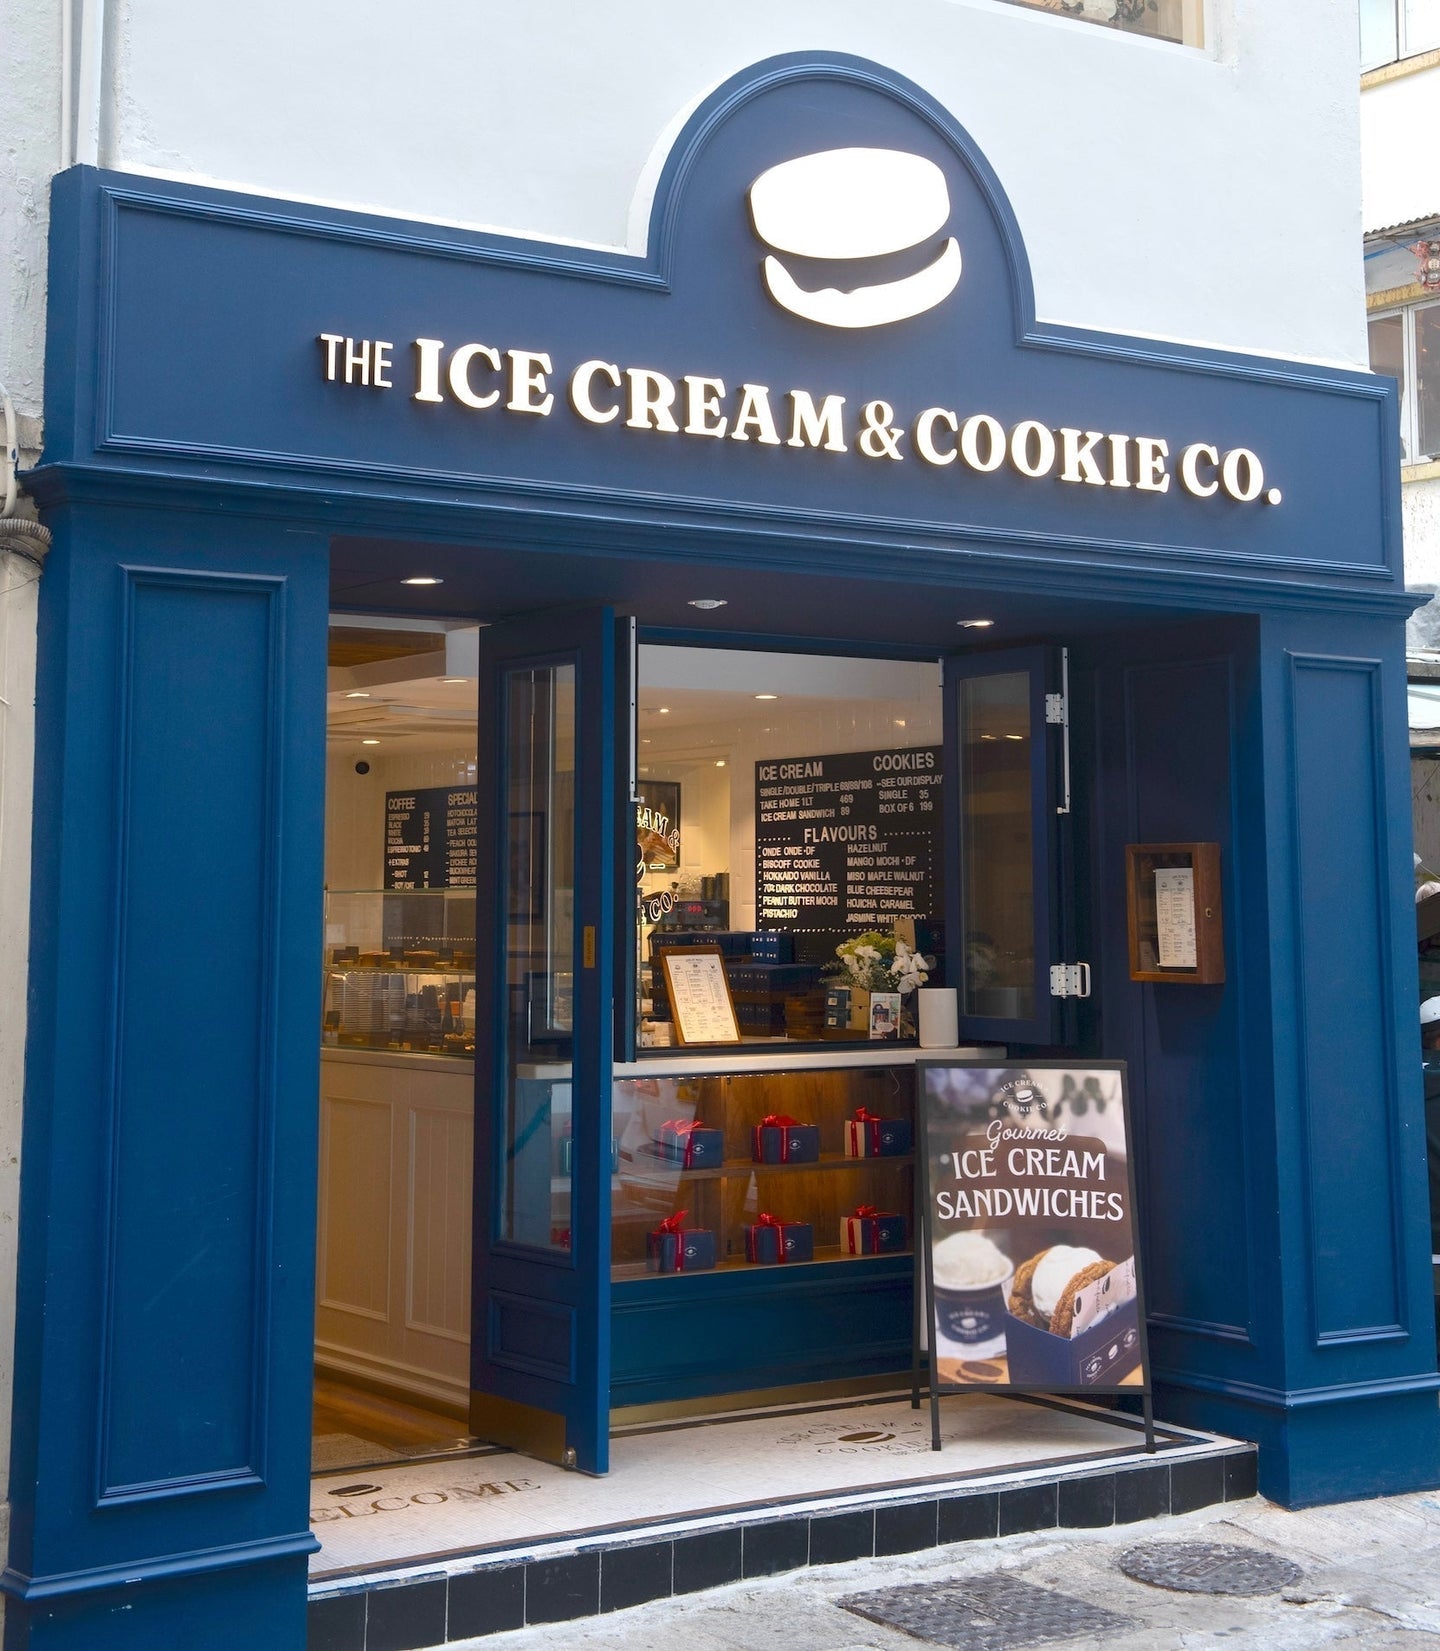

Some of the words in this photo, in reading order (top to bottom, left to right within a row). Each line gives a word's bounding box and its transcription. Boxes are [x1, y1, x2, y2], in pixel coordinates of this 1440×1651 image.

[320, 333, 394, 388] THE
[414, 338, 554, 416] ICE
[571, 360, 848, 453] CREAM
[858, 400, 904, 461] &
[915, 407, 1170, 493] COOKIE
[1181, 443, 1282, 506] CO.
[873, 752, 935, 771] COOKIES
[759, 766, 777, 781] ICE
[780, 761, 823, 779] CREAM
[913, 774, 943, 785] DISPLAY
[879, 790, 908, 800] SINGLE
[919, 789, 929, 799] 35
[388, 797, 416, 810] COFFEE
[760, 801, 778, 810] TAKE
[779, 798, 800, 808] HOME
[802, 797, 814, 806] 1LT
[840, 794, 854, 804] 469
[879, 803, 896, 813] BOX
[897, 803, 908, 812] OF
[909, 802, 914, 811] 6
[920, 801, 933, 811] 199
[761, 813, 773, 822] ICE
[773, 811, 797, 821] CREAM
[798, 809, 835, 819] SANDWICH
[840, 807, 850, 815] 89
[804, 825, 877, 843] FLAVOURS
[762, 847, 781, 856] ONDE
[784, 846, 803, 856] ONDE
[847, 842, 888, 853] HAZELNUT
[763, 860, 792, 868] BISCOFF
[793, 859, 820, 868] COOKIE
[847, 857, 874, 866] MANGO
[876, 856, 900, 866] MOCHI
[763, 872, 799, 881] HOKKAIDO
[800, 872, 831, 881] VANILLA
[847, 872, 865, 881] MISO
[868, 871, 893, 881] MAPLE
[894, 871, 925, 881] WALNUT
[776, 884, 795, 893] DARK
[795, 883, 838, 893] CHOCOLATE
[847, 884, 865, 894] BLUE
[763, 896, 788, 905] PEANUT
[788, 896, 815, 905] BUTTER
[816, 896, 838, 905] MOCHI
[847, 899, 877, 908] HOJICHA
[880, 900, 915, 909] CARAMEL
[763, 909, 798, 918] PISTACHIO
[846, 913, 876, 922] JASMINE
[986, 1119, 1067, 1150] Gourmet
[952, 1150, 997, 1180] ICE
[1007, 1148, 1106, 1181] CREAM
[936, 1188, 1124, 1221] SANDWICHES
